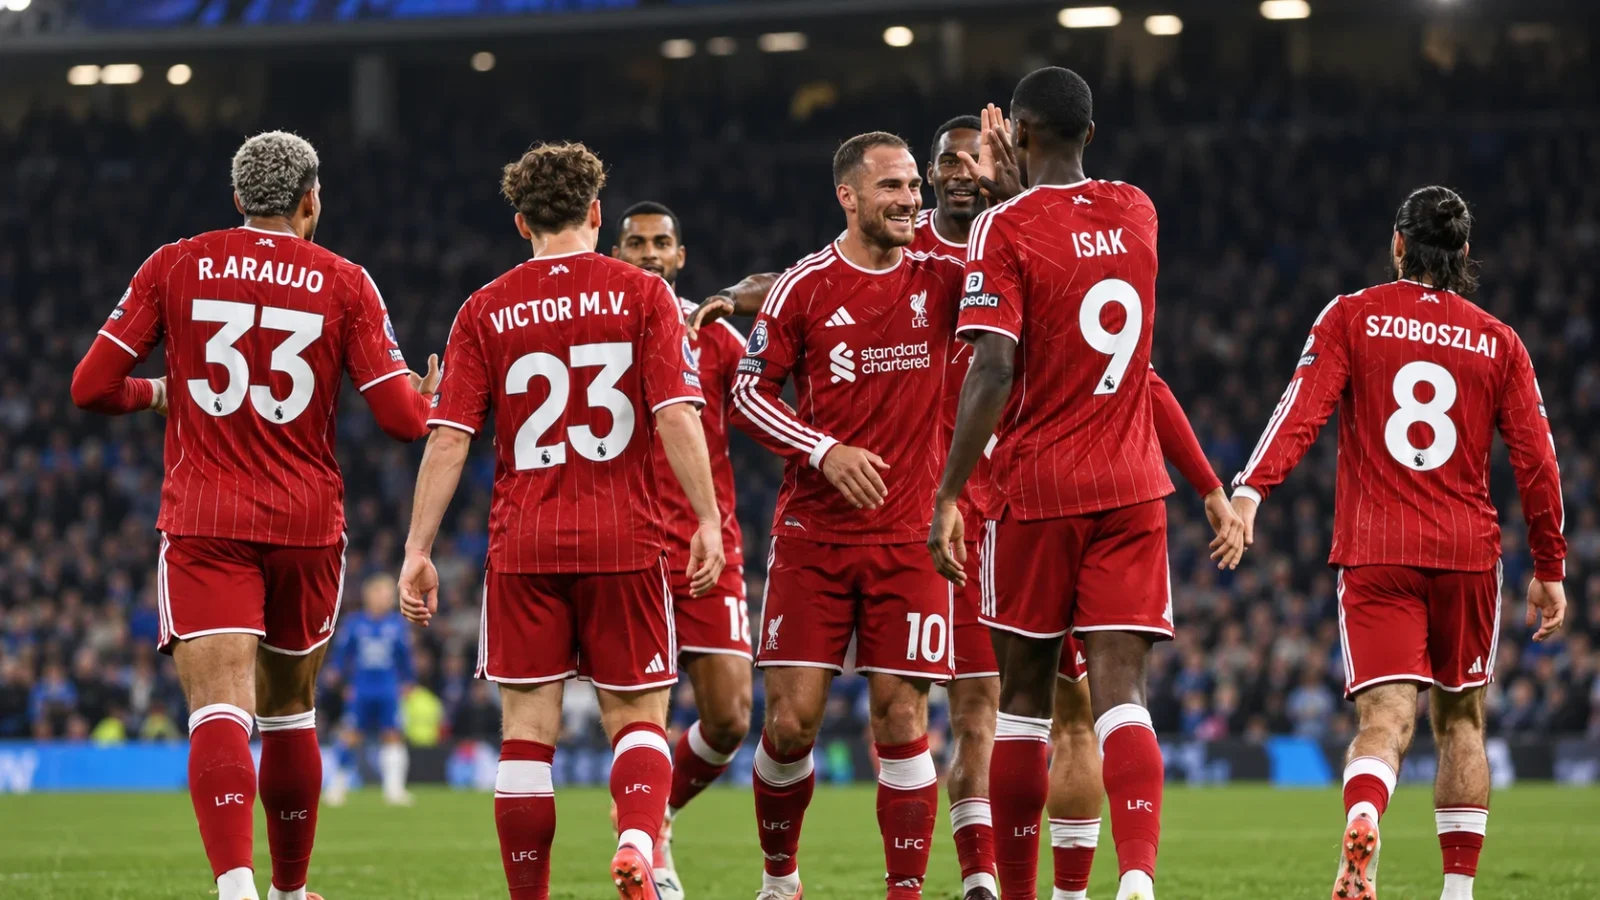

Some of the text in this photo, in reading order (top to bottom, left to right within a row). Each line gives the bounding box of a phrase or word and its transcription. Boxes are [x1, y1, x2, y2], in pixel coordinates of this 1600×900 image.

[1071, 227, 1128, 259] ISAK
[198, 255, 325, 294] R.ARAUJO
[489, 290, 630, 334] VICTOR M.V.
[911, 319, 930, 329] LFC
[1078, 278, 1143, 396] 9
[1365, 314, 1498, 360] SZOBOSZLAI
[860, 340, 928, 361] standard
[186, 298, 325, 425] 33
[861, 353, 931, 374] chartered
[504, 341, 636, 471] 23
[1383, 360, 1458, 472] 8
[905, 611, 947, 663] 10
[625, 783, 651, 794] LFC
[215, 793, 244, 806] LFC
[1127, 799, 1153, 813] LFC
[280, 809, 308, 821] LFC
[762, 819, 791, 831] LFC
[1014, 824, 1037, 838] LFC
[895, 837, 924, 850] LFC
[511, 850, 538, 862] LFC
